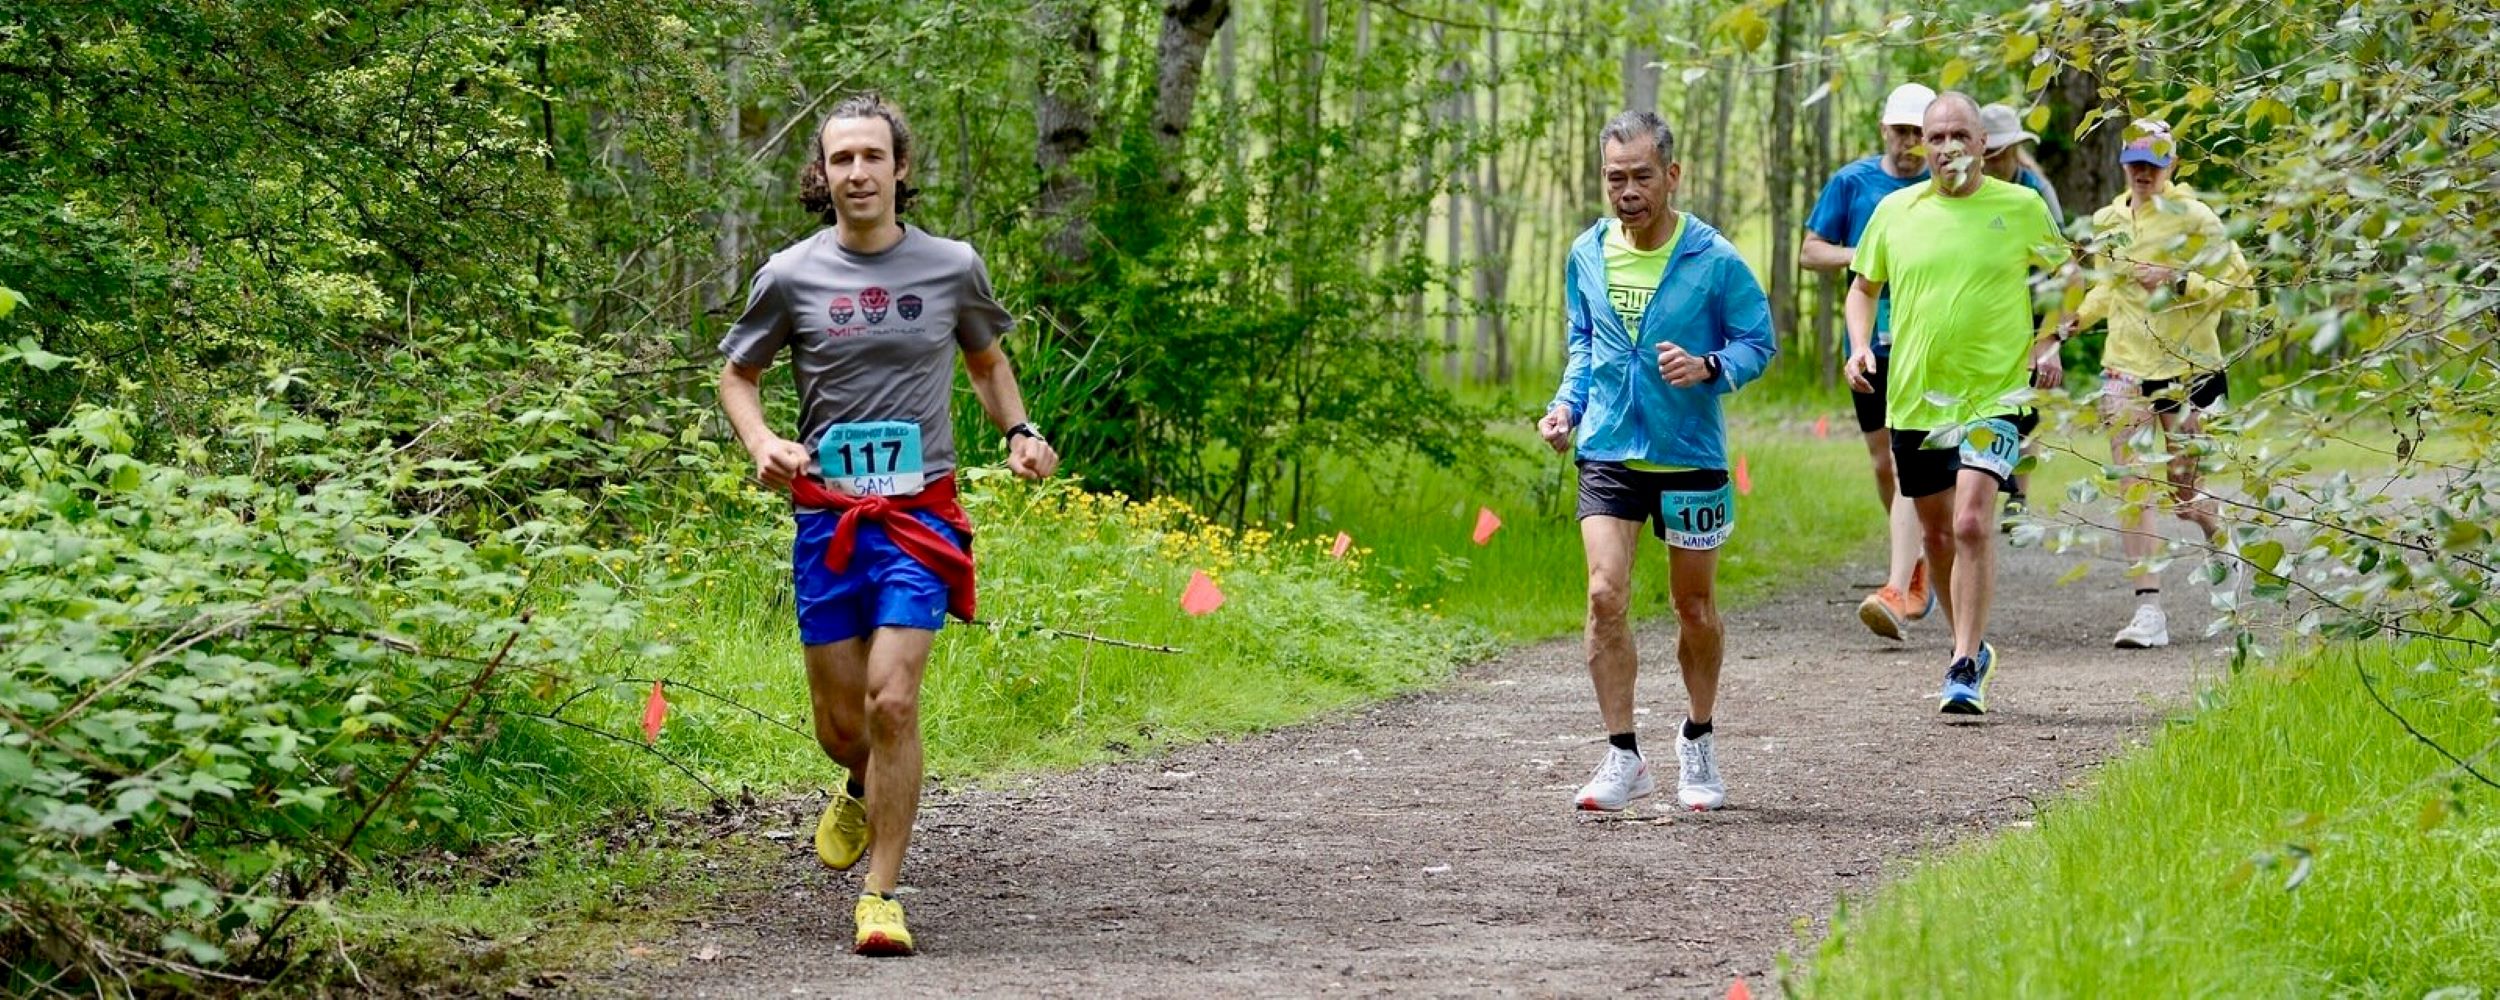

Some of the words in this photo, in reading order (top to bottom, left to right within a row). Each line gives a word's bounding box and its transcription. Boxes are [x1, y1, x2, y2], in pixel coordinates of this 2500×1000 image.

[827, 326, 866, 337] MIT
[838, 440, 902, 475] 117
[1990, 433, 2015, 459] 07
[854, 476, 895, 495] SAM
[1678, 502, 1725, 532] 109
